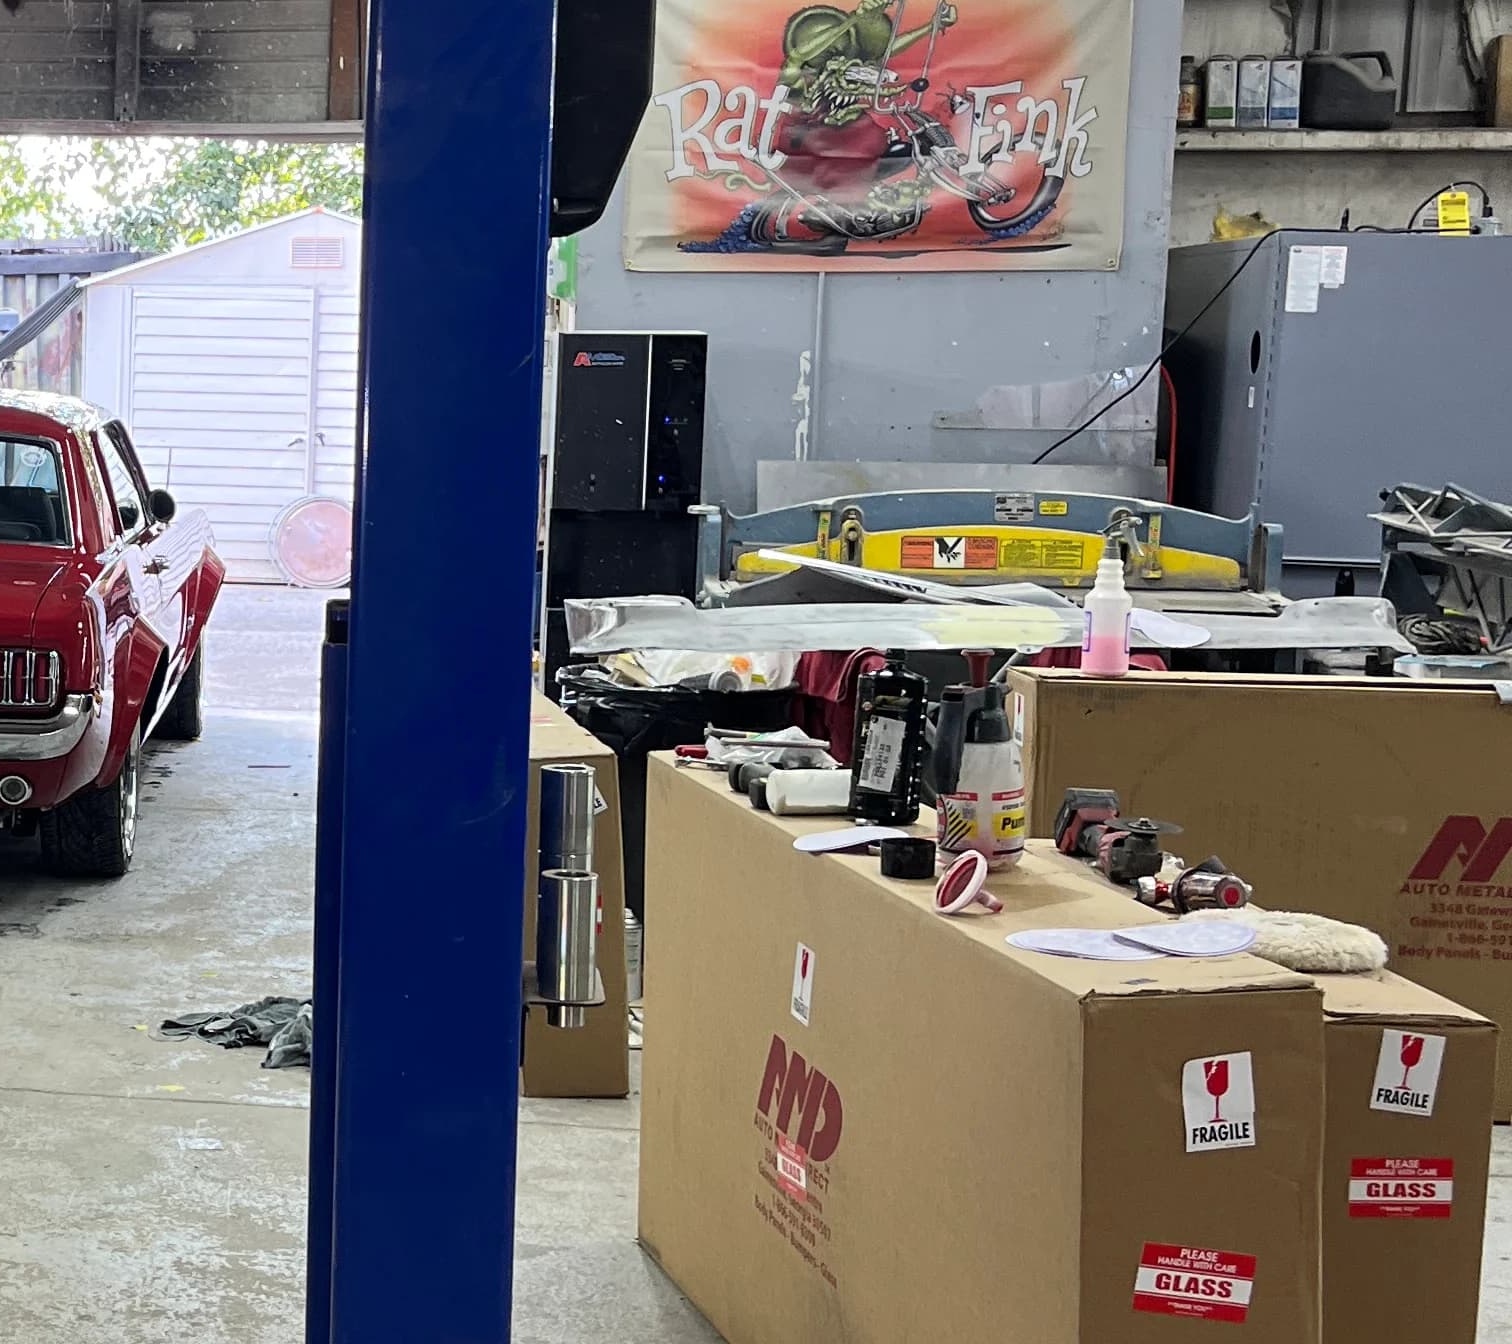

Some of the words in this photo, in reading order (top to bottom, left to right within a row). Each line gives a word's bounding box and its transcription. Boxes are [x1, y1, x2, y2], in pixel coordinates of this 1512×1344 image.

[653, 78, 793, 184] Rat
[958, 75, 1100, 179] Fink
[1400, 882, 1450, 896] AUTO
[1376, 1087, 1430, 1109] FRAGILE
[754, 1112, 774, 1141] AUTO
[1192, 1122, 1251, 1145] FRAGILE
[1385, 1159, 1420, 1169] PLEASE
[1417, 1168, 1438, 1177] CARE
[1366, 1182, 1436, 1198] GLASS
[1180, 1248, 1219, 1263] PLEASE
[1157, 1256, 1191, 1268] HANDLE
[1192, 1260, 1213, 1271] WITH
[1214, 1263, 1237, 1274] CARE
[1155, 1273, 1233, 1299] GLASS
